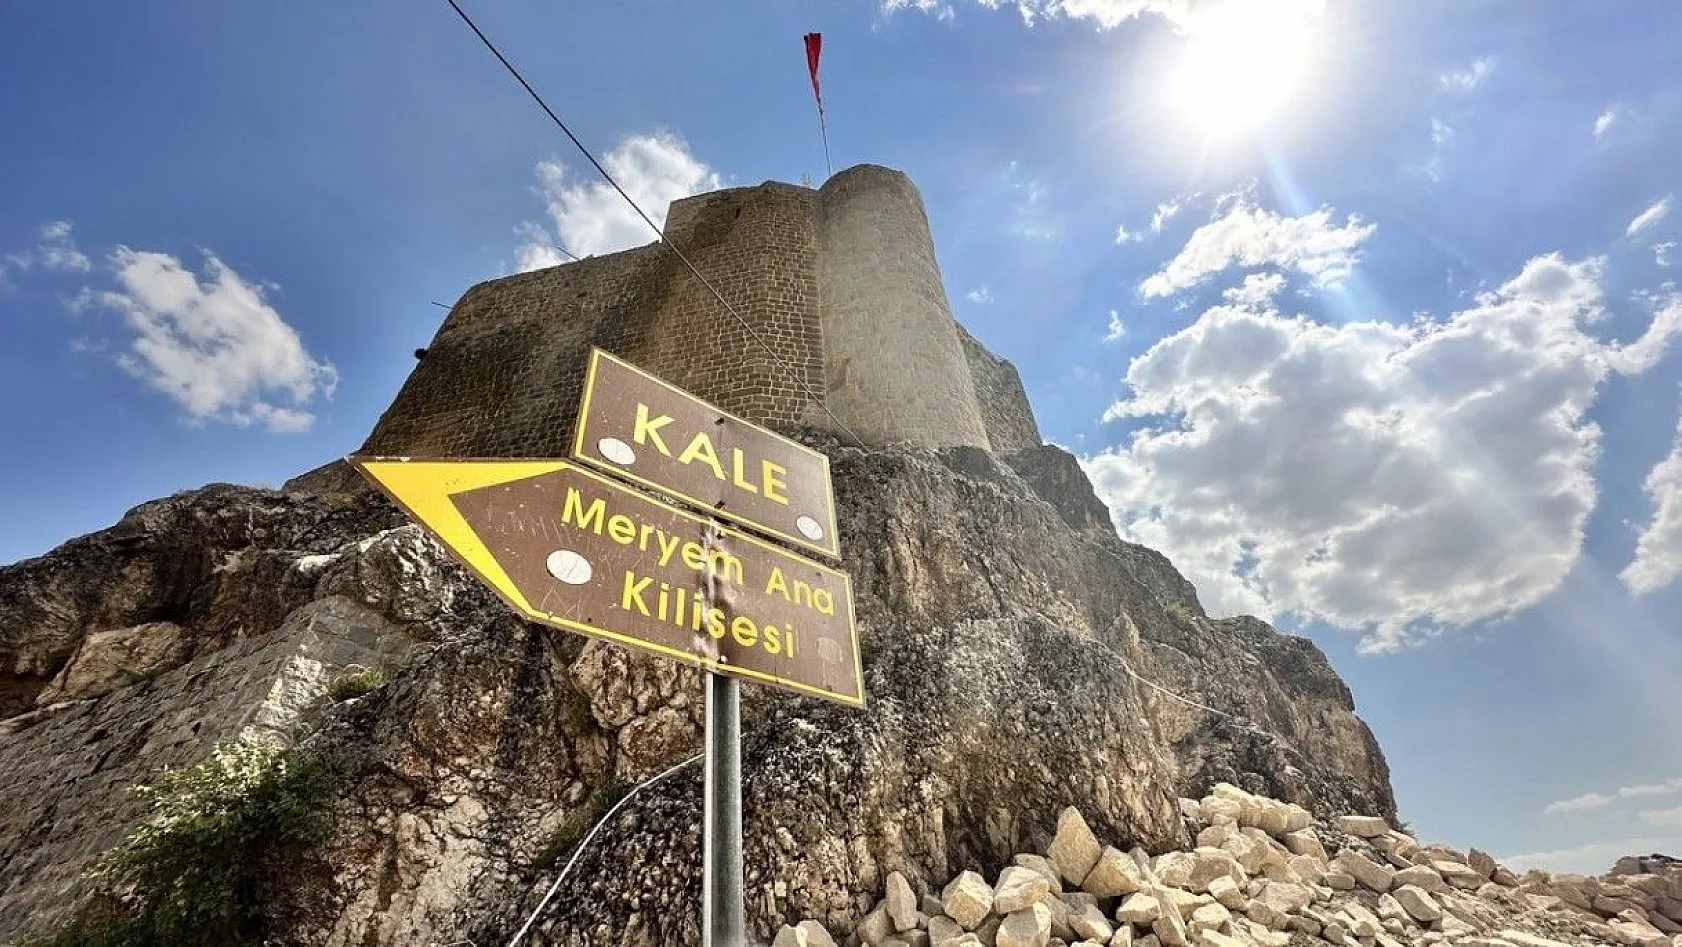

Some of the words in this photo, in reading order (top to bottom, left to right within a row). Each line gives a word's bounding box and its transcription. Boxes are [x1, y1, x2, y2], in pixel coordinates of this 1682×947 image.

[632, 403, 789, 505] KALE
[561, 487, 744, 585] Meryem
[765, 566, 835, 616] Ana
[622, 569, 795, 659] Kilisesi
